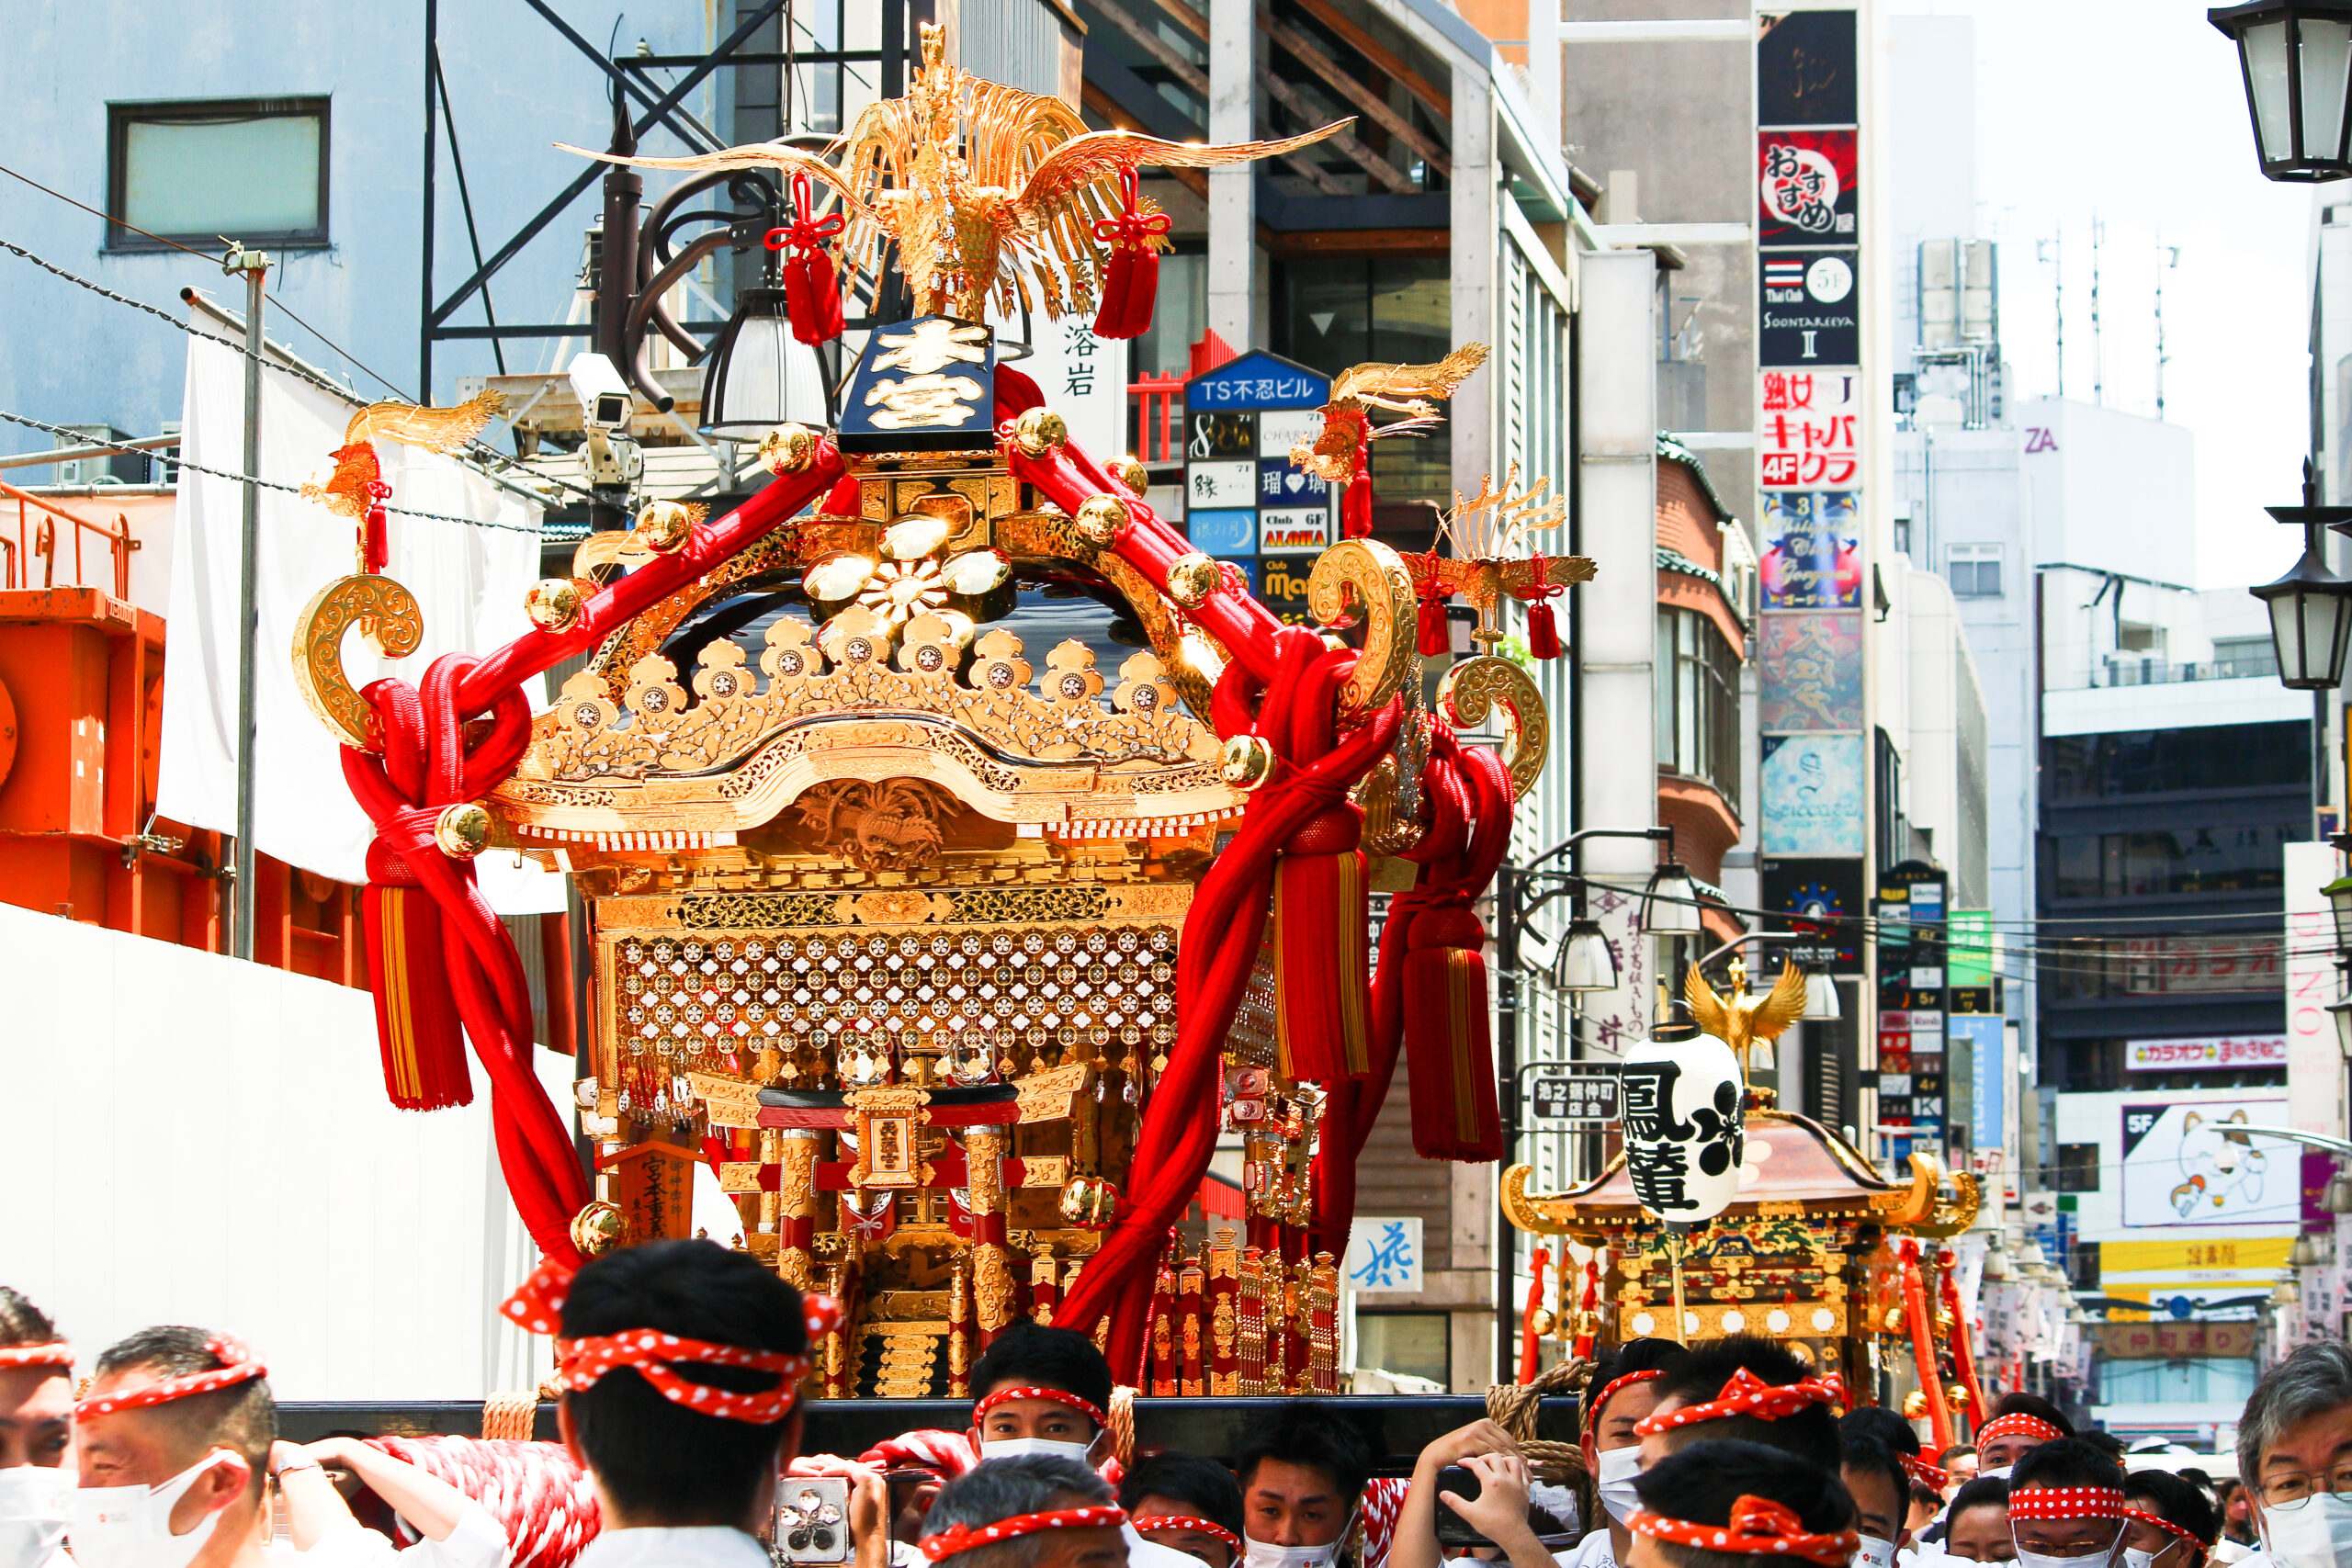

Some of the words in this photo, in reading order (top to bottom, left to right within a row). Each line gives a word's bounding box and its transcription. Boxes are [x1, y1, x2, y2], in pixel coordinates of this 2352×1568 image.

[1785, 288, 1804, 303] Club
[1201, 377, 1314, 400] TS不忍ビル
[1763, 372, 1815, 412] 熟女
[1763, 414, 1856, 450] キャバ
[1764, 456, 1797, 481] 4F
[1802, 451, 1857, 485] クラ
[1266, 515, 1294, 525] Club
[1306, 513, 1326, 525] 6F
[1263, 530, 1326, 547] ALOHA
[1266, 560, 1288, 570] Club
[1266, 573, 1310, 601] Ma
[1538, 1081, 1615, 1101] 池之端仲町
[1550, 1101, 1601, 1117] 商店会
[2128, 1114, 2154, 1134] 5F
